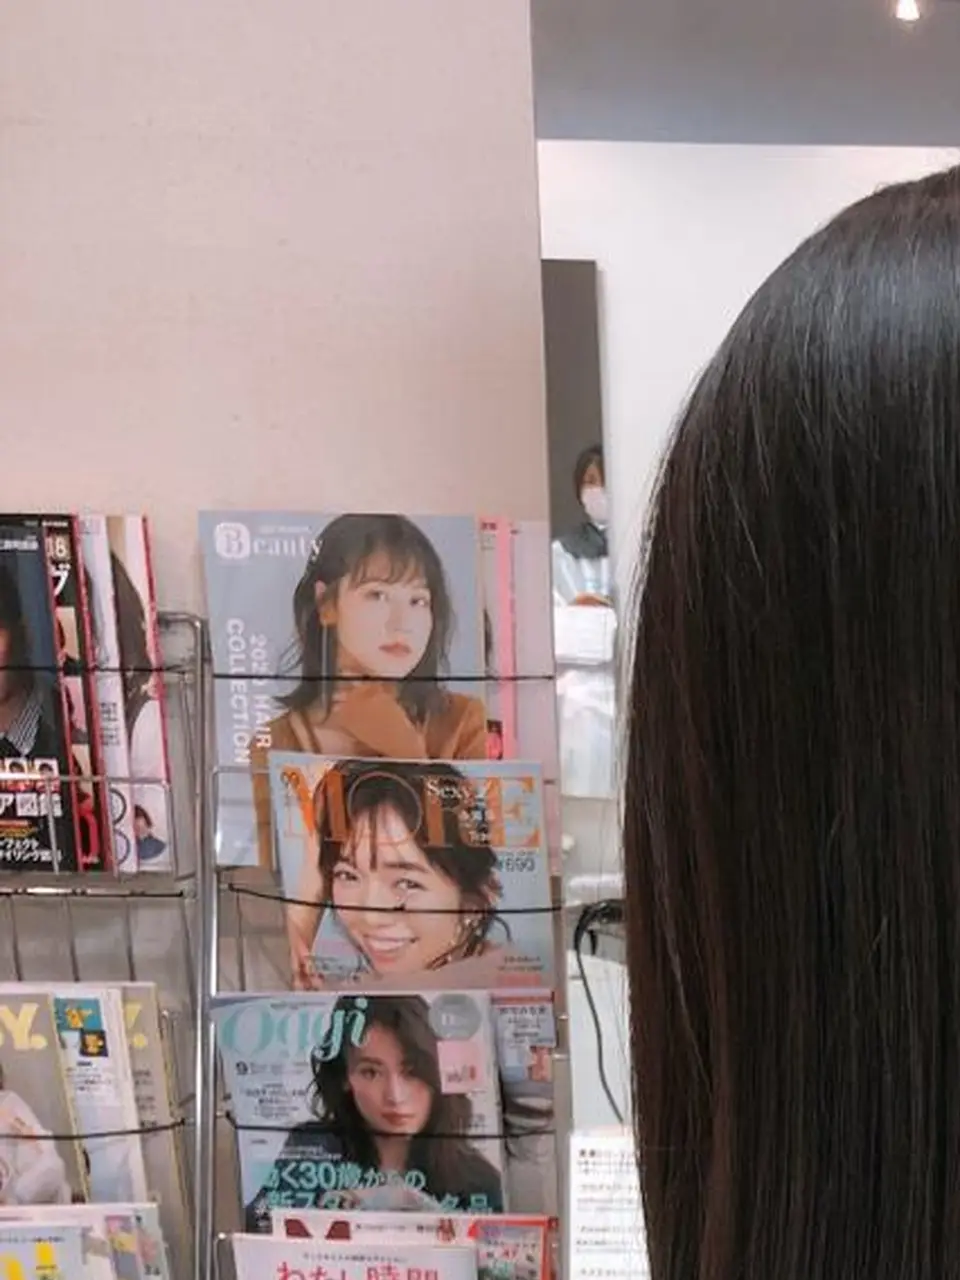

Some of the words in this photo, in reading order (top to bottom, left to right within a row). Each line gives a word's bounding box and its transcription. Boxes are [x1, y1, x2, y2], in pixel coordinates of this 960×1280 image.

[226, 617, 251, 764] COLLECTION
[254, 694, 273, 749] HAIR
[221, 998, 371, 1062] Oggi
